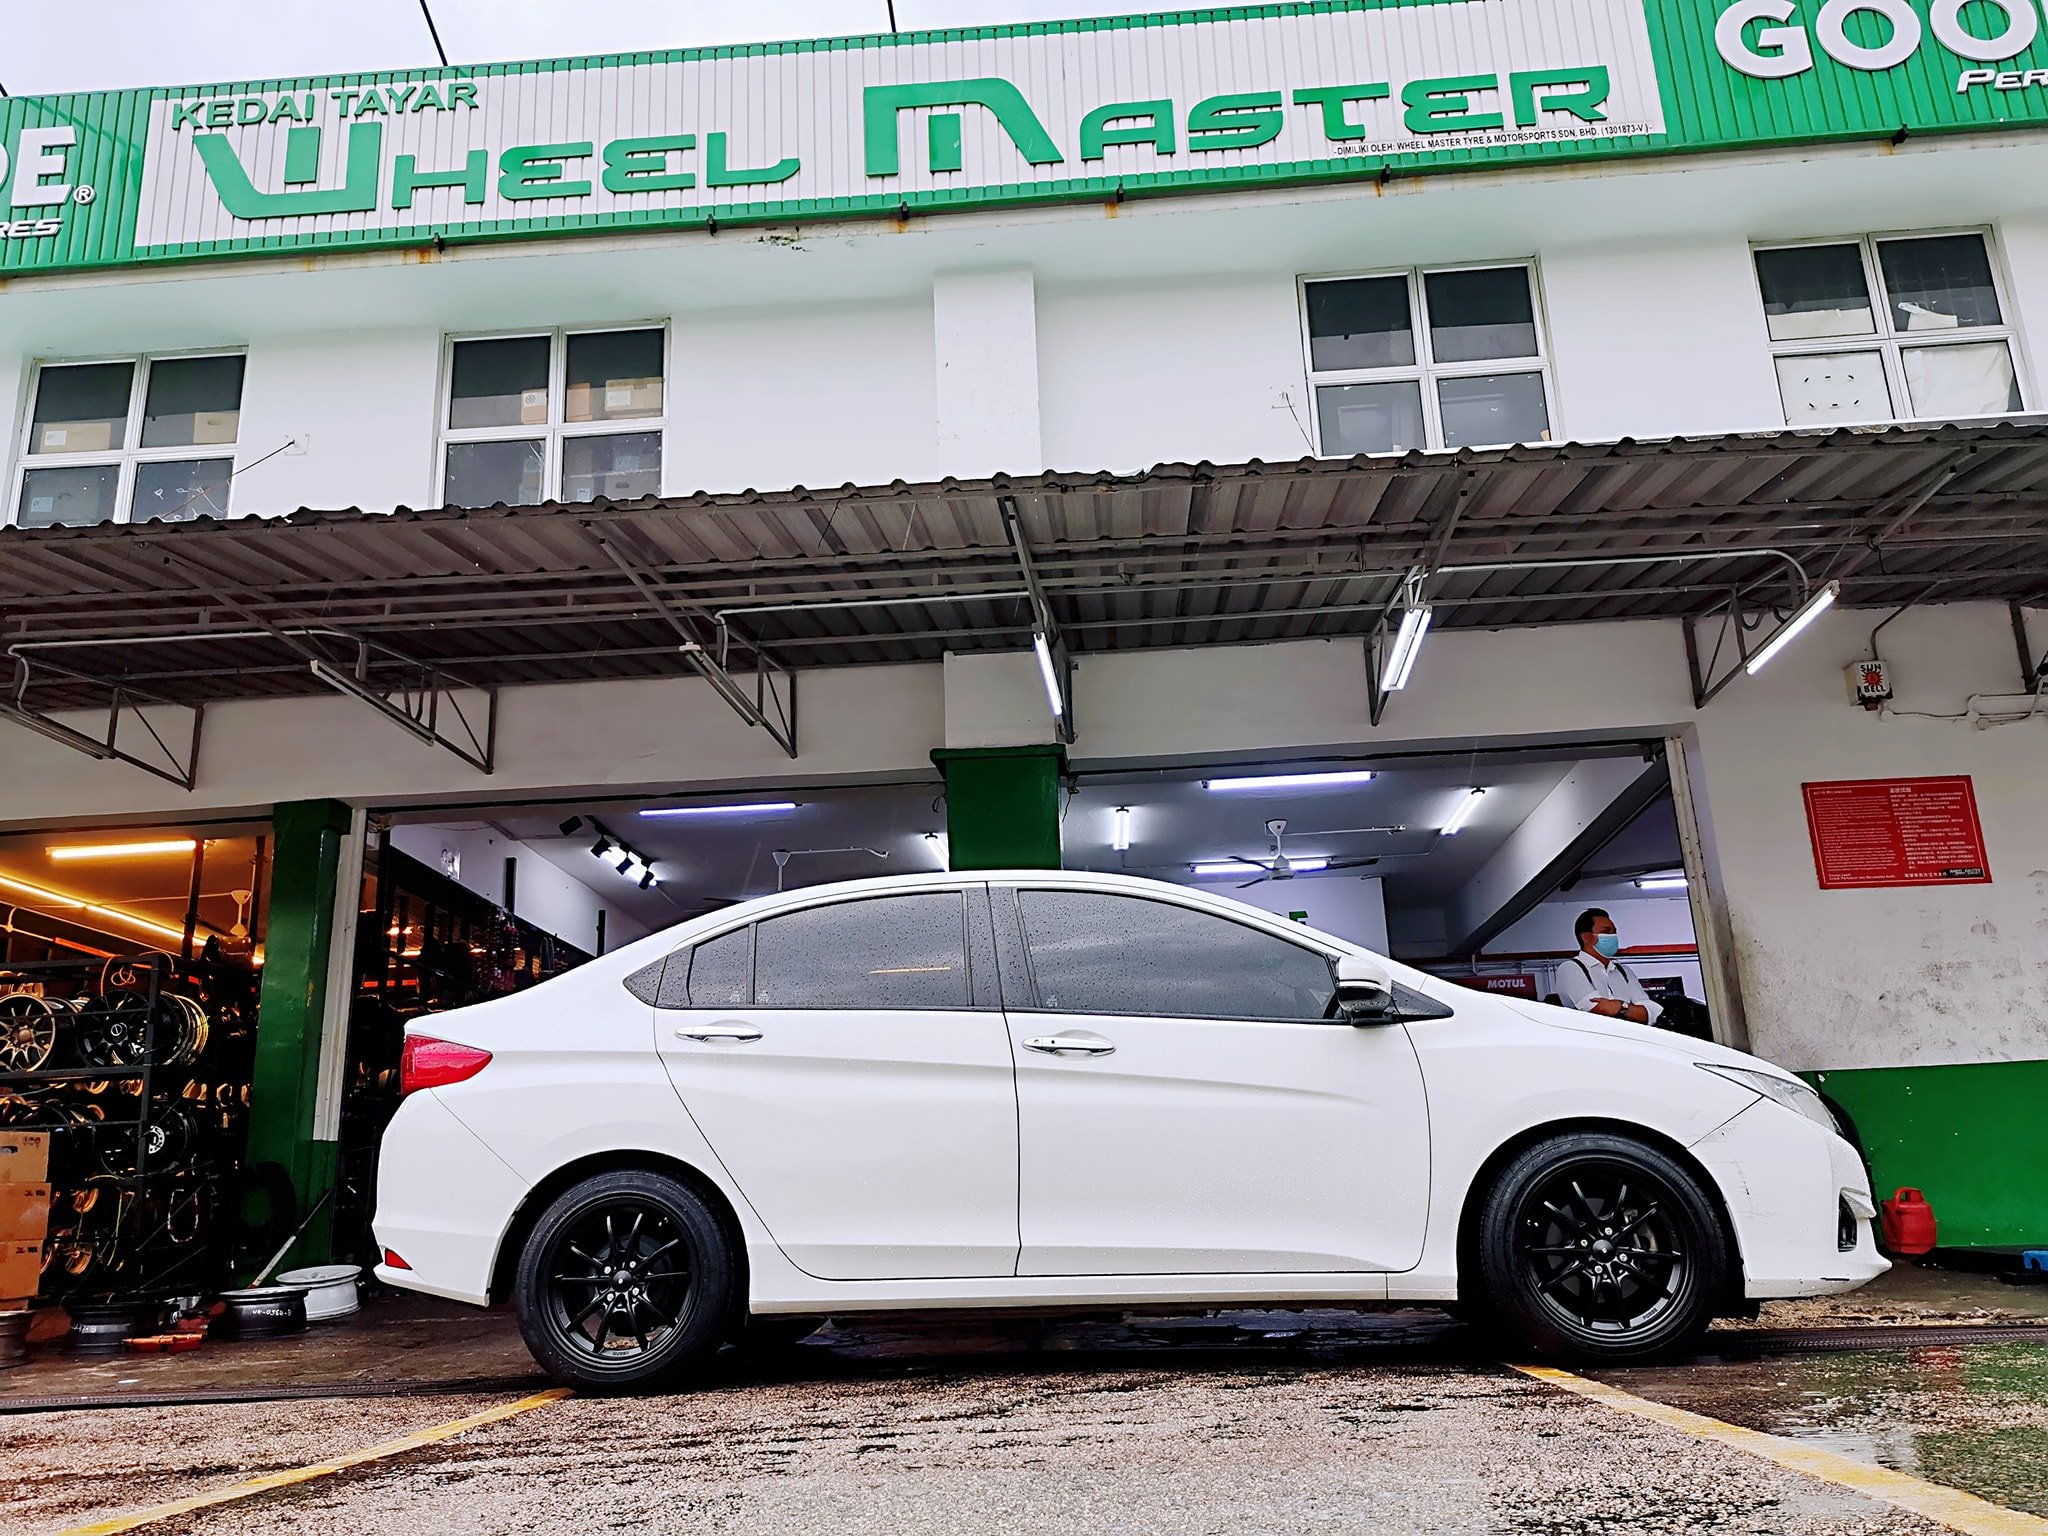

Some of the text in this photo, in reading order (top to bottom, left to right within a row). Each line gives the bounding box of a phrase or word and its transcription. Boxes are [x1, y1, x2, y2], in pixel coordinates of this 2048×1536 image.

[1715, 0, 2048, 79] GOO
[172, 82, 478, 131] KEDAI TAYAR
[193, 65, 1611, 220] WHEEL MASTER
[1370, 143, 1396, 153] OLEH:
[1399, 140, 1426, 151] WHEEL
[1427, 137, 1461, 149] MASTER
[1463, 135, 1484, 146] TYRE
[1486, 134, 1493, 144] &
[1494, 130, 1557, 143] MOTORSPORTS
[0, 126, 77, 208] E
[1860, 663, 1882, 672] SUN
[1863, 684, 1886, 693] BELL
[1487, 978, 1526, 989] MOTUL
